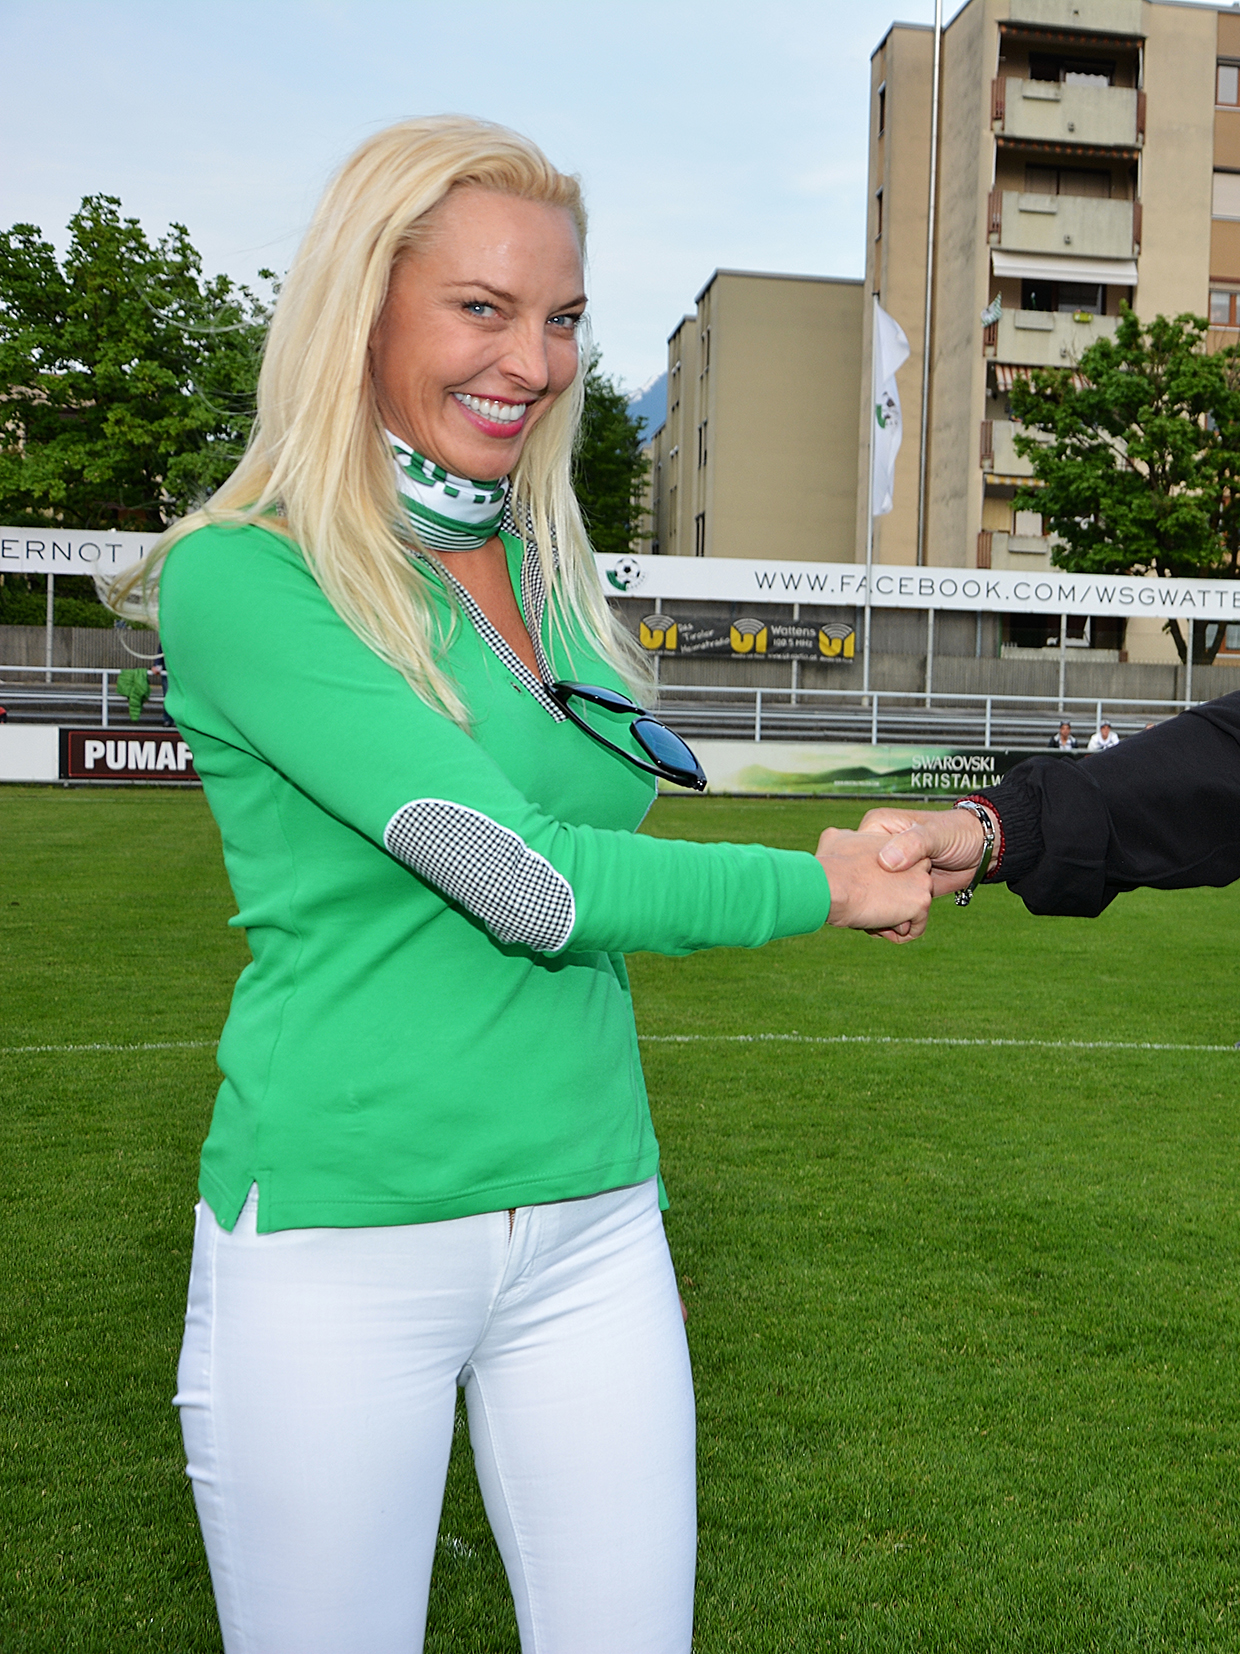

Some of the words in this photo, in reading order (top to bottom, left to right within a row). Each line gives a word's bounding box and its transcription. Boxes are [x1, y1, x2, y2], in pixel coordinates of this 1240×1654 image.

[1, 539, 123, 563] ERNOT
[770, 625, 816, 637] Wattens
[912, 755, 995, 771] SWAROVSKI
